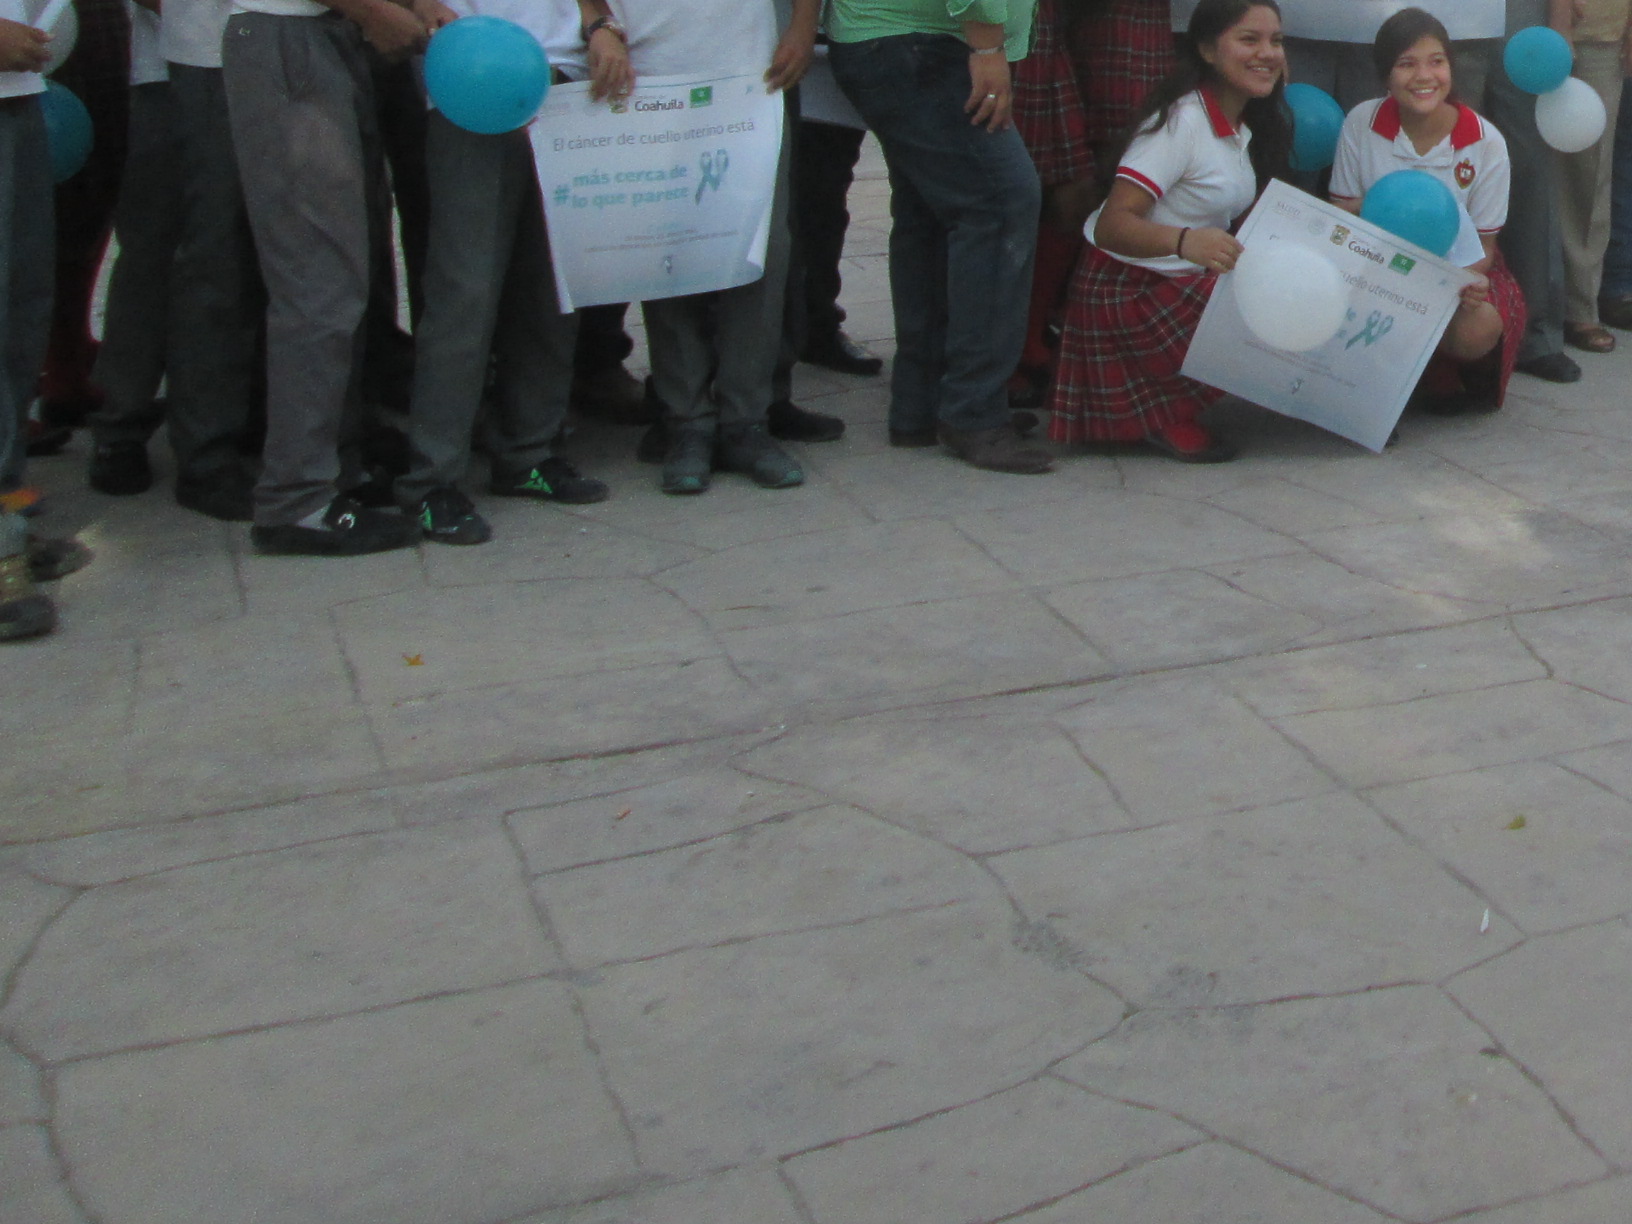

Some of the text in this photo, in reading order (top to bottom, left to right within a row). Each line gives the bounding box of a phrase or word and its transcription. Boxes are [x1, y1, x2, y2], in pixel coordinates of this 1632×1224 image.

[634, 99, 684, 112] Coahuila
[553, 118, 755, 151] El cáncer de cuello uterino está
[573, 168, 610, 187] más
[614, 169, 666, 183] cerca
[669, 164, 687, 177] de
[572, 185, 689, 210] lo que parece
[1348, 241, 1385, 264] Coahuila
[1368, 284, 1404, 304] uterino
[1405, 300, 1428, 315] está
